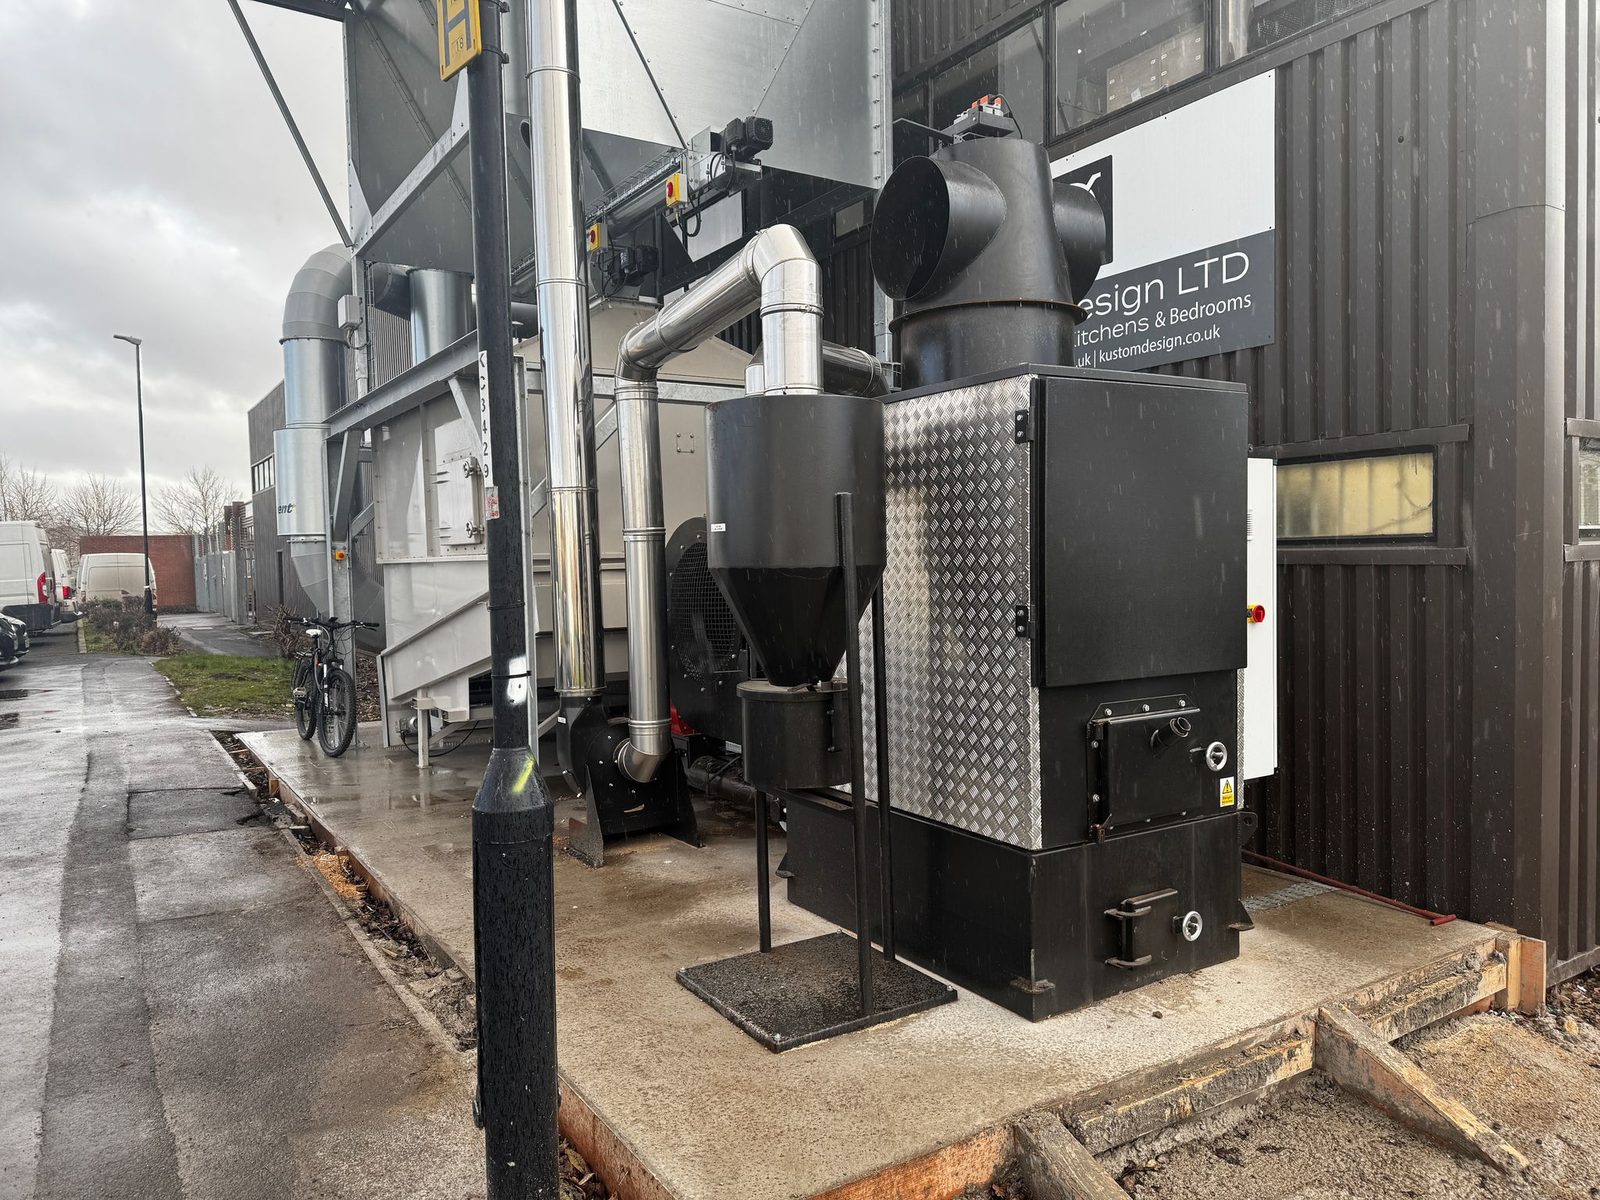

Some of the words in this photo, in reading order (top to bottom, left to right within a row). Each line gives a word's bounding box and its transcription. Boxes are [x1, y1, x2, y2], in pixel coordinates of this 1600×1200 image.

[1078, 279, 1164, 320] esign
[1178, 252, 1250, 296] LTD
[1074, 317, 1149, 348] itchens
[1155, 311, 1166, 328] &
[1170, 294, 1252, 325] Bedrooms
[1100, 324, 1221, 363] kustomdesign.co.uk
[278, 503, 293, 514] ent
